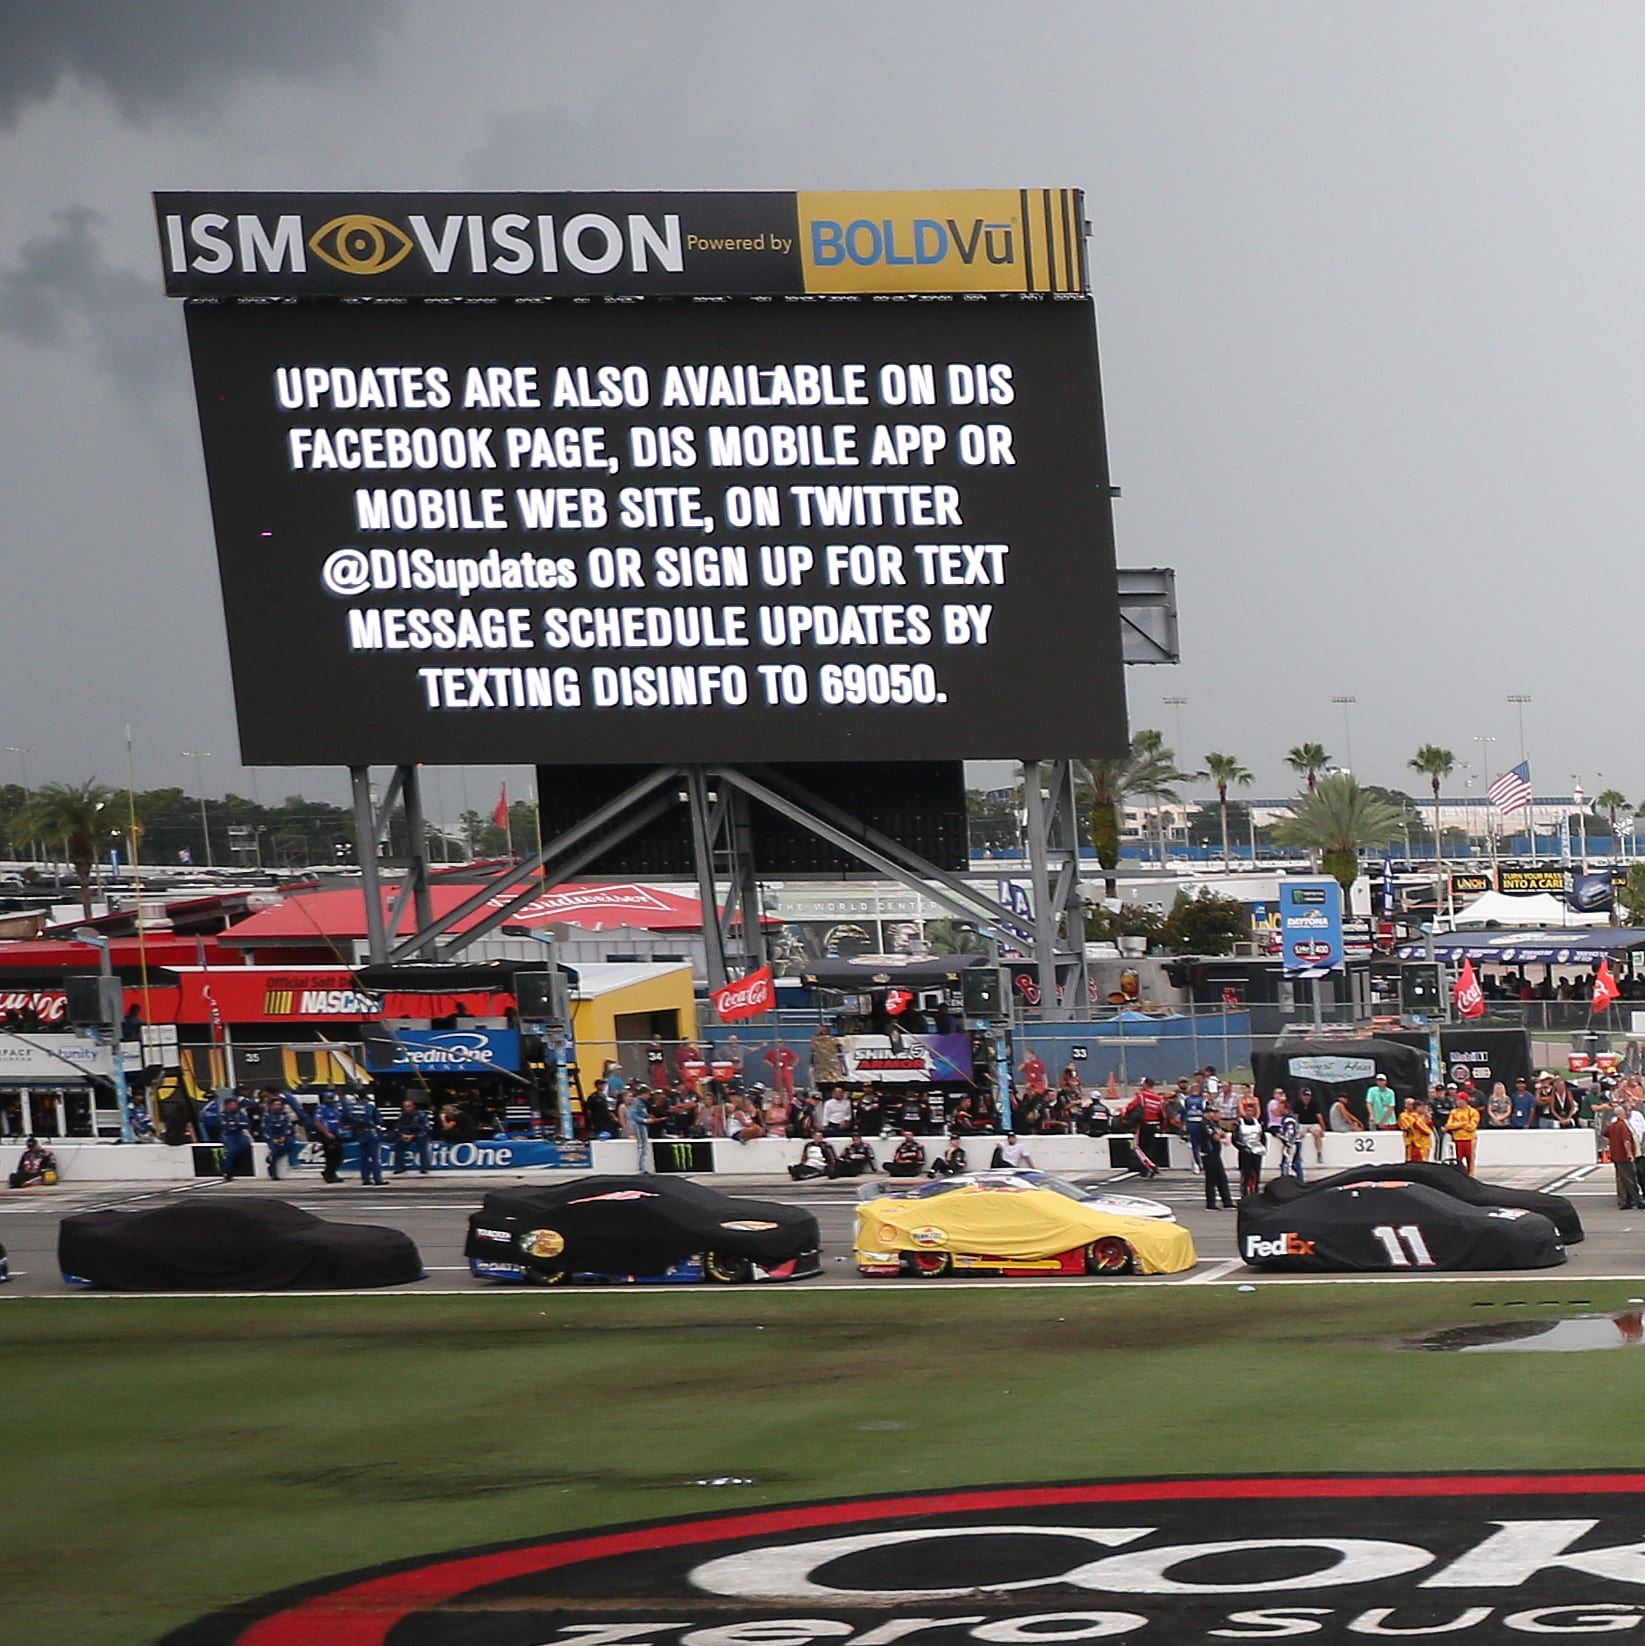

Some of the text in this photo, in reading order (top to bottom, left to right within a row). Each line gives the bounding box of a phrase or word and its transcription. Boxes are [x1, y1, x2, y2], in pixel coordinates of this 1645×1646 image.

[165, 212, 307, 274] ISM
[408, 212, 685, 273] VISION
[687, 233, 765, 251] Powered
[769, 233, 792, 255] by
[277, 364, 1014, 408] UPDATES ARE ALSO AVAILABLE ON DIS
[290, 425, 1015, 473] FACEBOOK PAGE, DIS MOBILE APP OR
[356, 486, 962, 533] MOBILE WEB SITE, ON TWITTER
[323, 545, 1008, 596] @DISupdates OR SIGN UP FOR TEXT
[349, 605, 992, 648] MESSAGE SCHEDULE UPDATES BY
[419, 664, 946, 707] TEXTING DISINFO TO 69050.
[1503, 880, 1526, 888] INTO
[813, 901, 869, 912] WORLD
[1286, 916, 1329, 929] DAYTONA
[245, 1052, 260, 1063] 35
[648, 1051, 662, 1062] 34
[856, 1058, 925, 1070] ARMOR
[1073, 1047, 1088, 1059] 33
[296, 1142, 327, 1164] 42
[1354, 1138, 1375, 1152] 32
[1246, 1232, 1316, 1257] FedEx
[1372, 1224, 1437, 1267] 11
